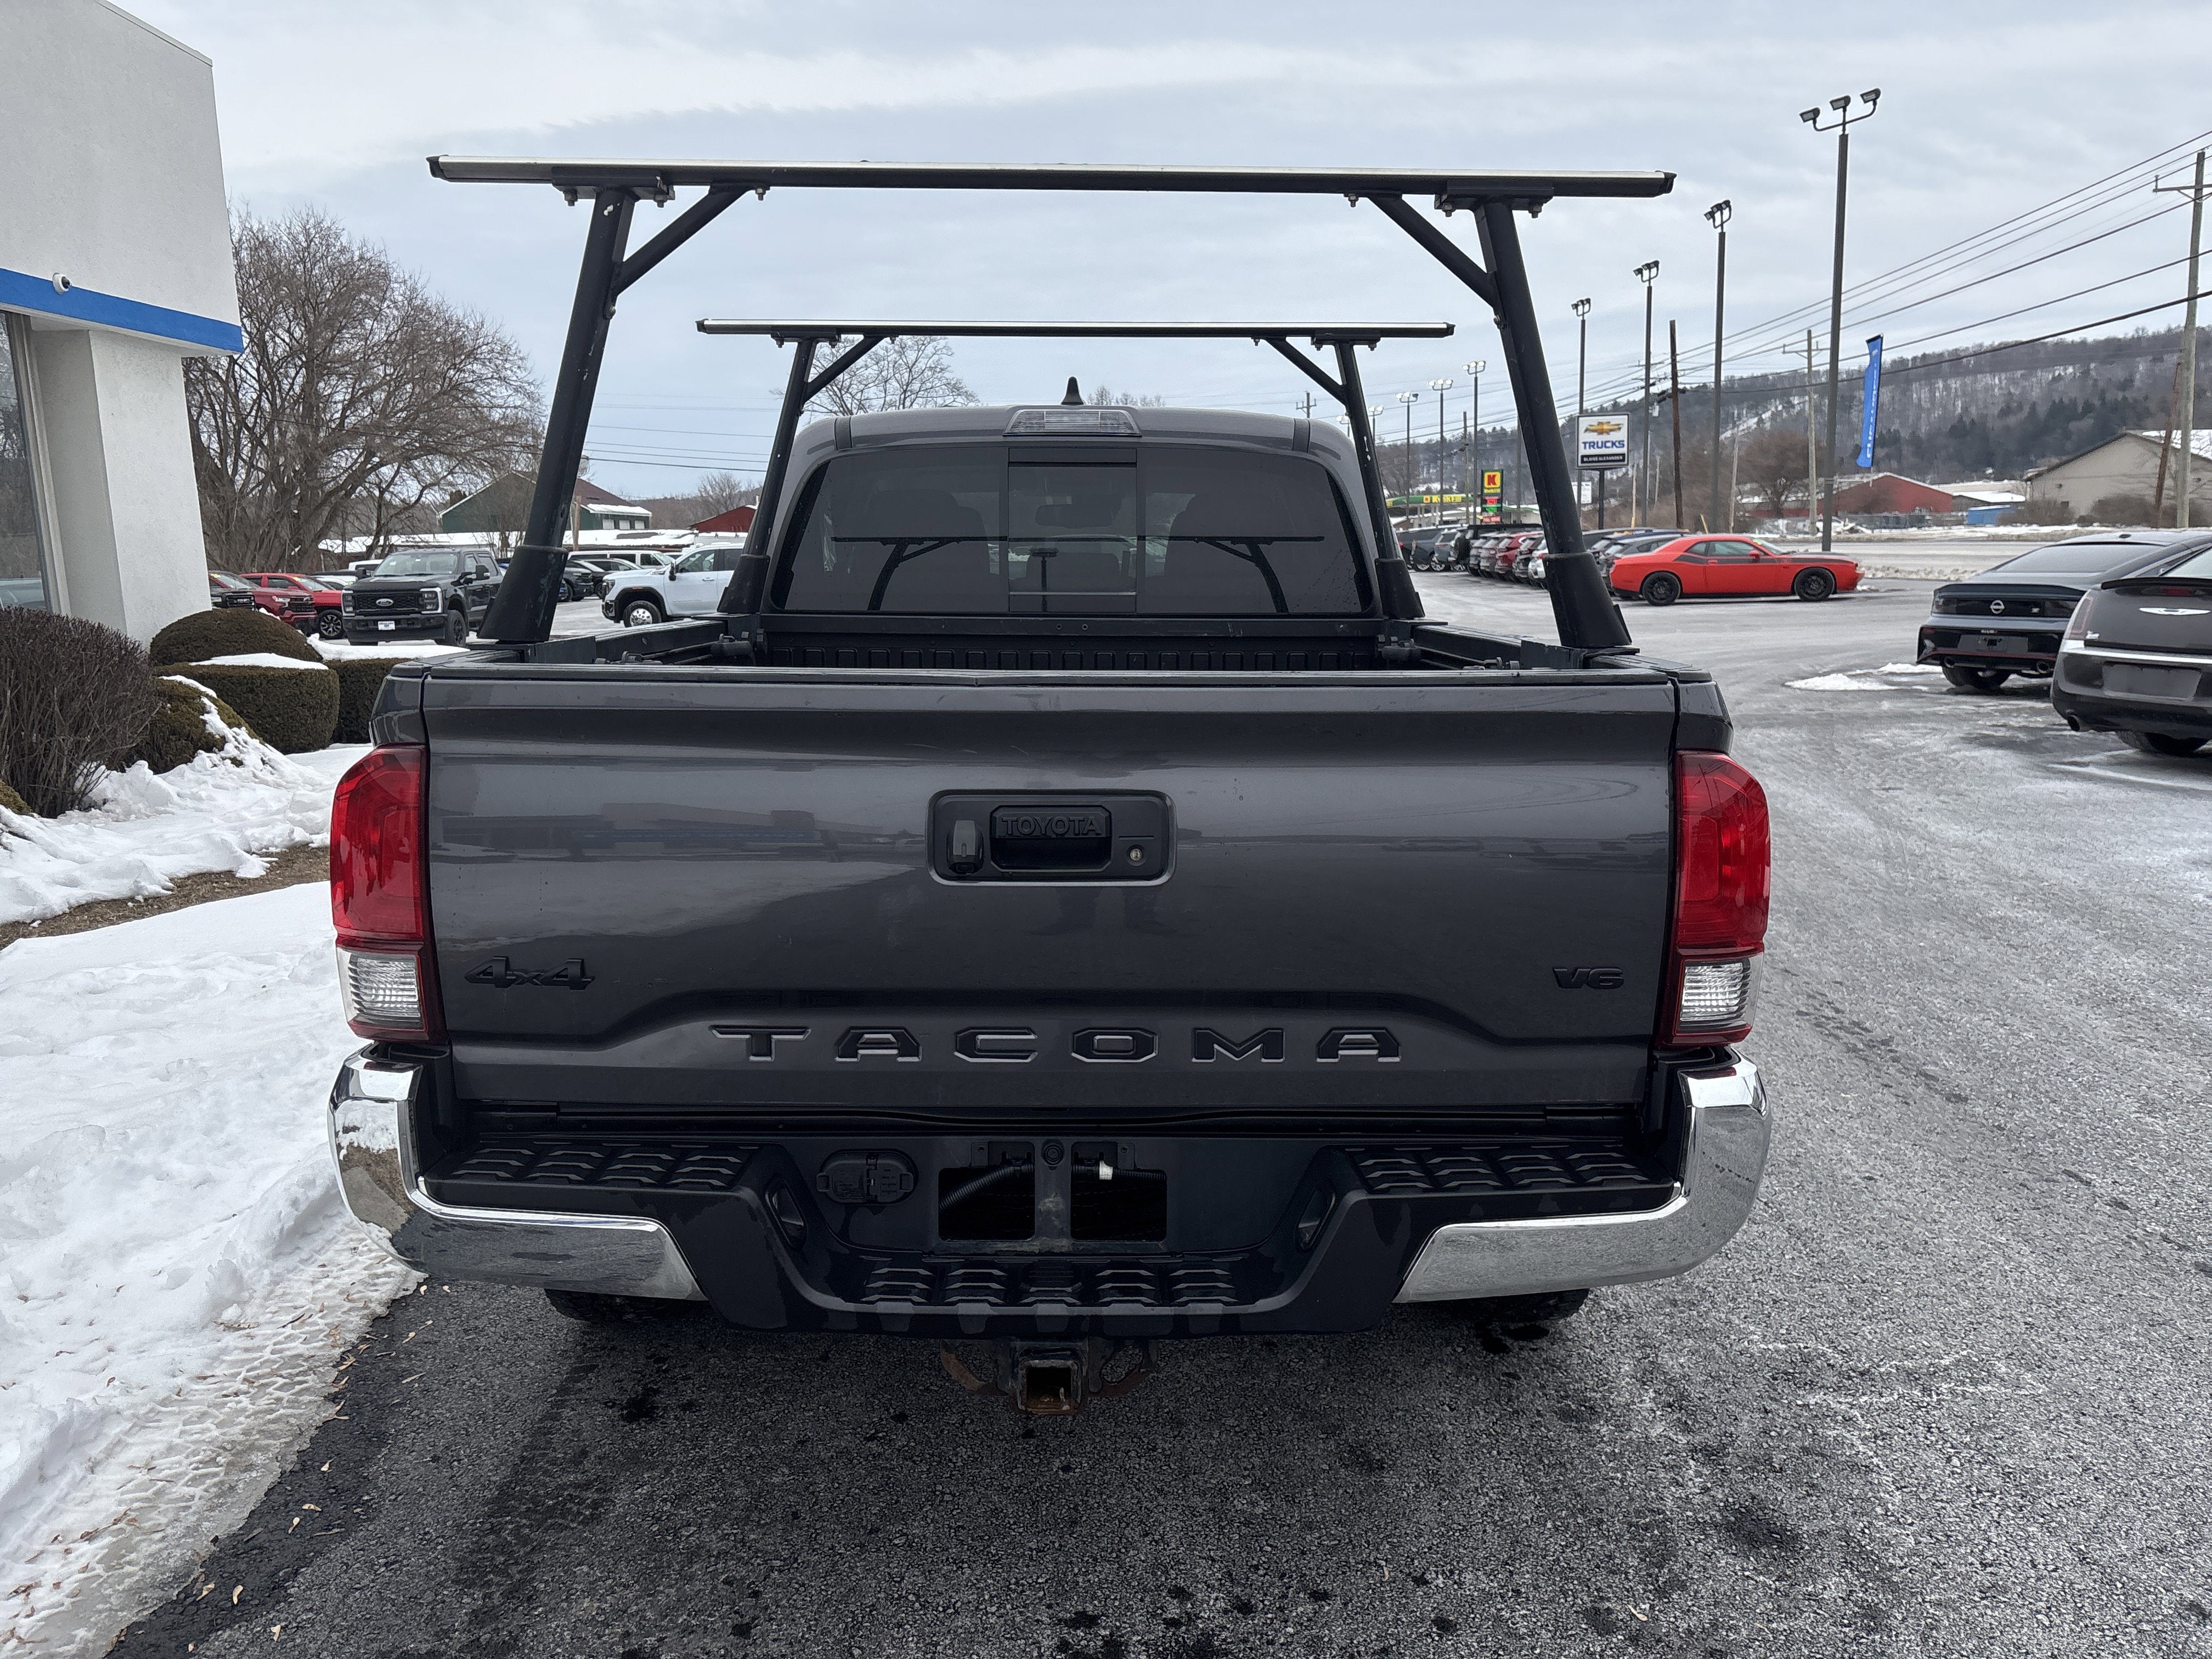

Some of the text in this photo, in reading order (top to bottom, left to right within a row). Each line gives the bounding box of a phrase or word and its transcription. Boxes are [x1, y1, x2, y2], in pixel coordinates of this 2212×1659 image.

[1582, 440, 1625, 450] TRUCKS
[1487, 475, 1497, 486] K
[1001, 816, 1102, 837] TOYOTA
[1552, 967, 1624, 989] V6
[709, 1025, 1402, 1063] TACOMA
